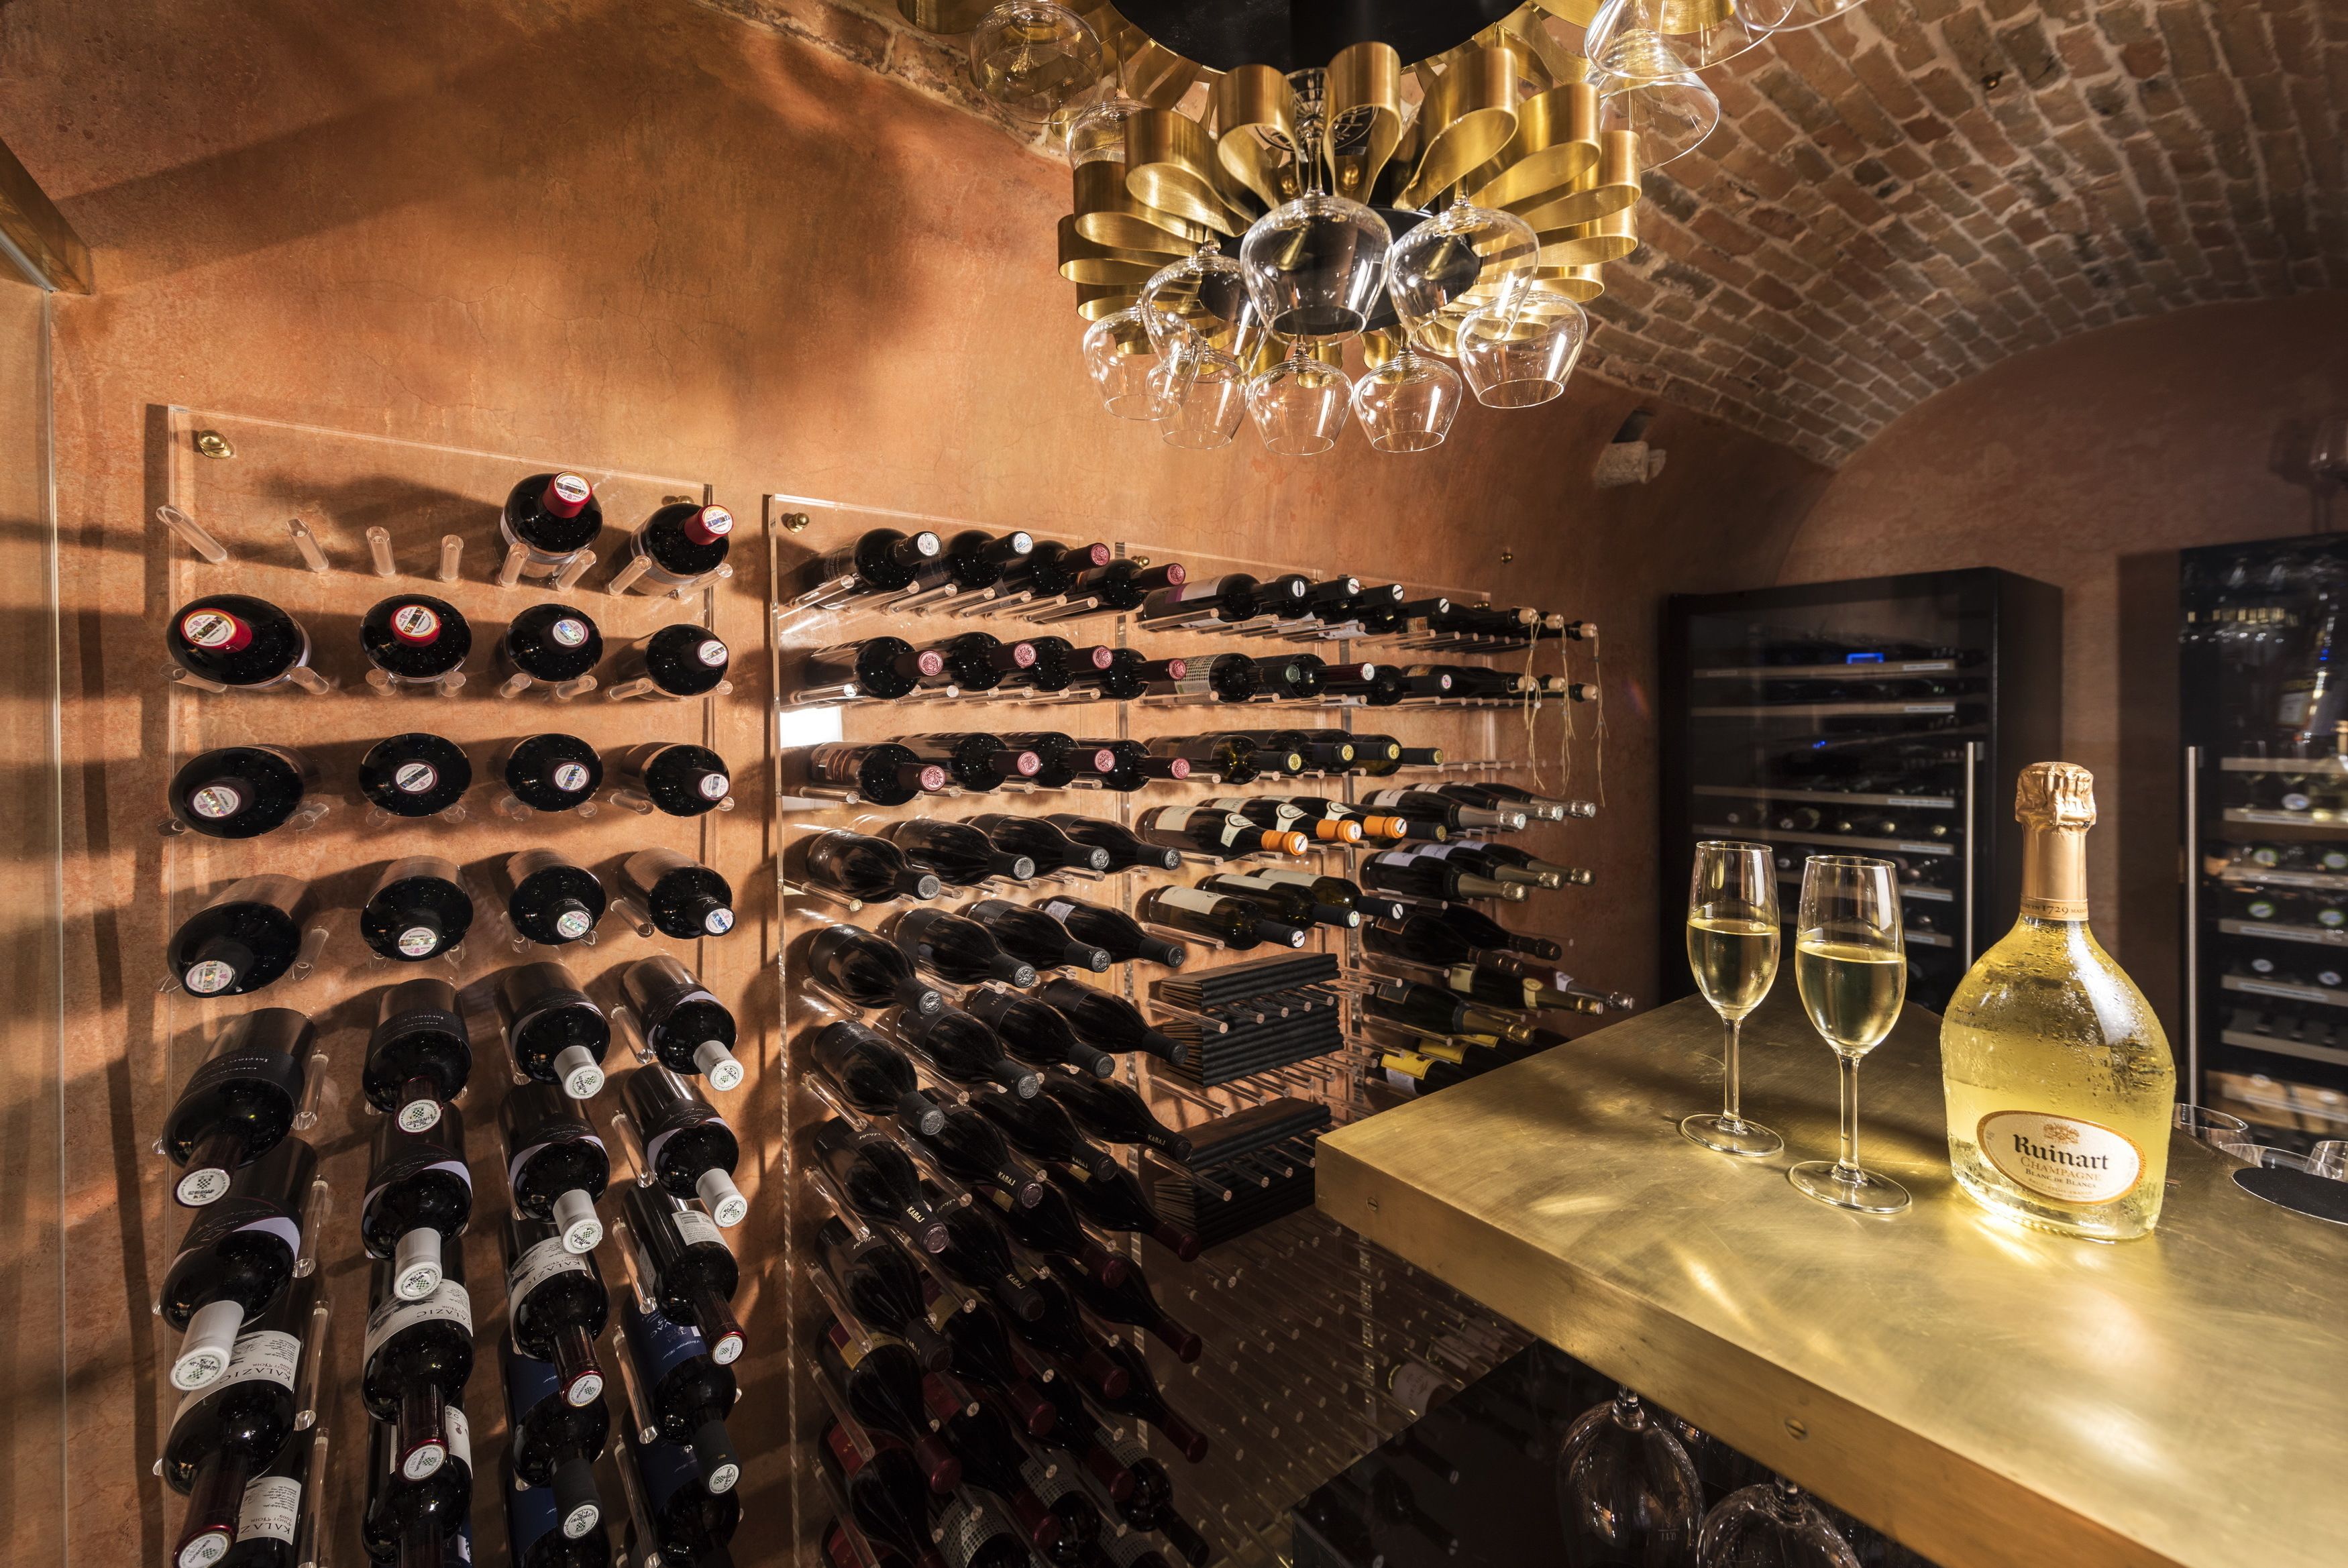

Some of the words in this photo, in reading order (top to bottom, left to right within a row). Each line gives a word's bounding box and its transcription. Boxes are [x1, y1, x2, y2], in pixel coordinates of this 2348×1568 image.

[2042, 905, 2068, 915] 1729
[1148, 1134, 1166, 1145] KABAJ
[2013, 1134, 2109, 1170] Ruinart
[1072, 1156, 1088, 1169] KABAJ
[2021, 1156, 2101, 1181] CHAMPAGNE
[997, 1172, 1016, 1186] KABAJ
[2025, 1168, 2051, 1181] BLANC
[2066, 1178, 2096, 1188] BLANCS
[906, 1206, 925, 1223] KABAJ
[1006, 1273, 1026, 1289] KABAJ
